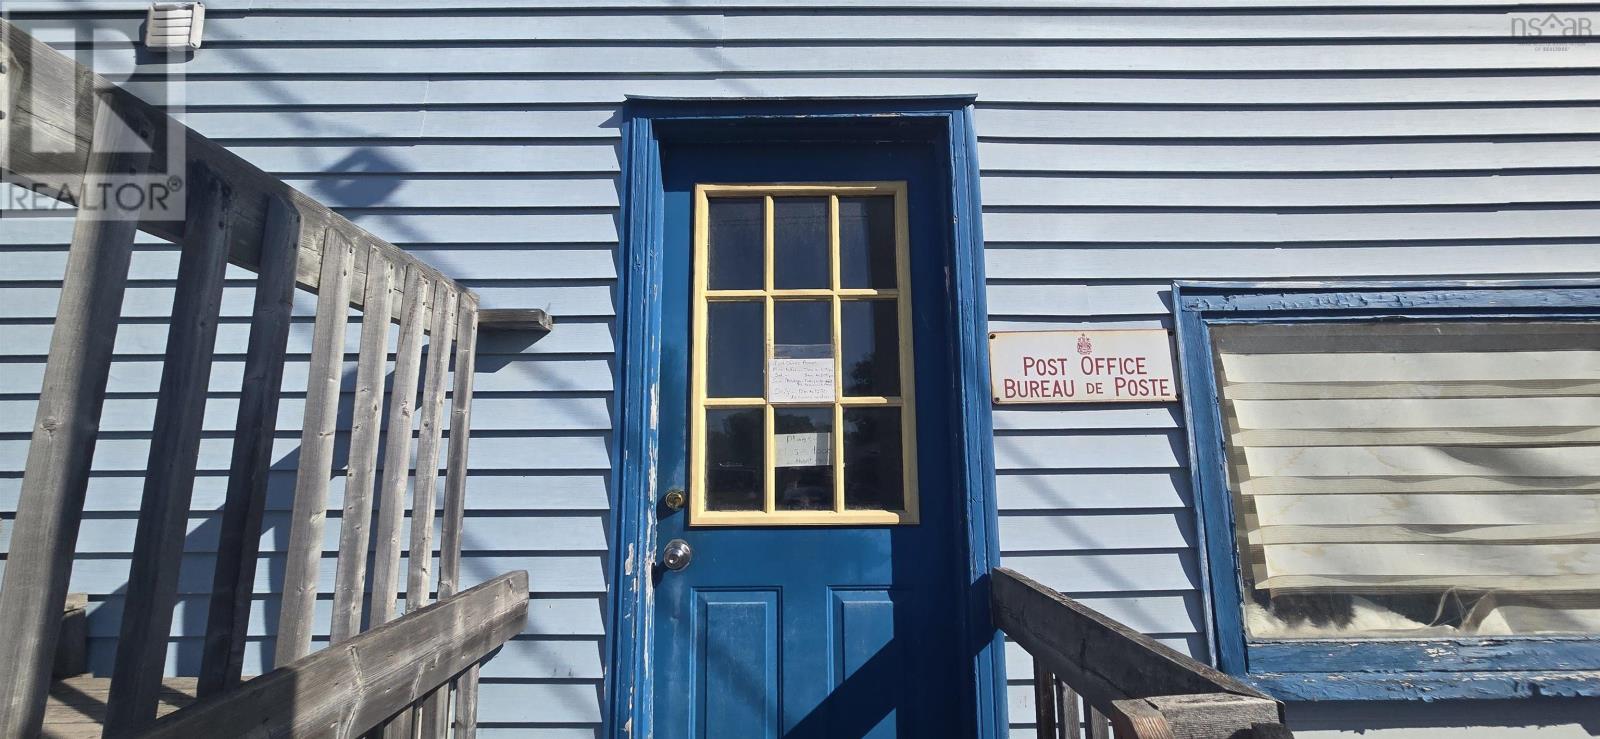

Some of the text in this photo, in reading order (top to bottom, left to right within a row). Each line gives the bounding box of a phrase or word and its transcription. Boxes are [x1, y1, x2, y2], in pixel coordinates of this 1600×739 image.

[1024, 356, 1147, 376] POST OFFICE
[1004, 377, 1171, 398] BUREAU DE POSTE
